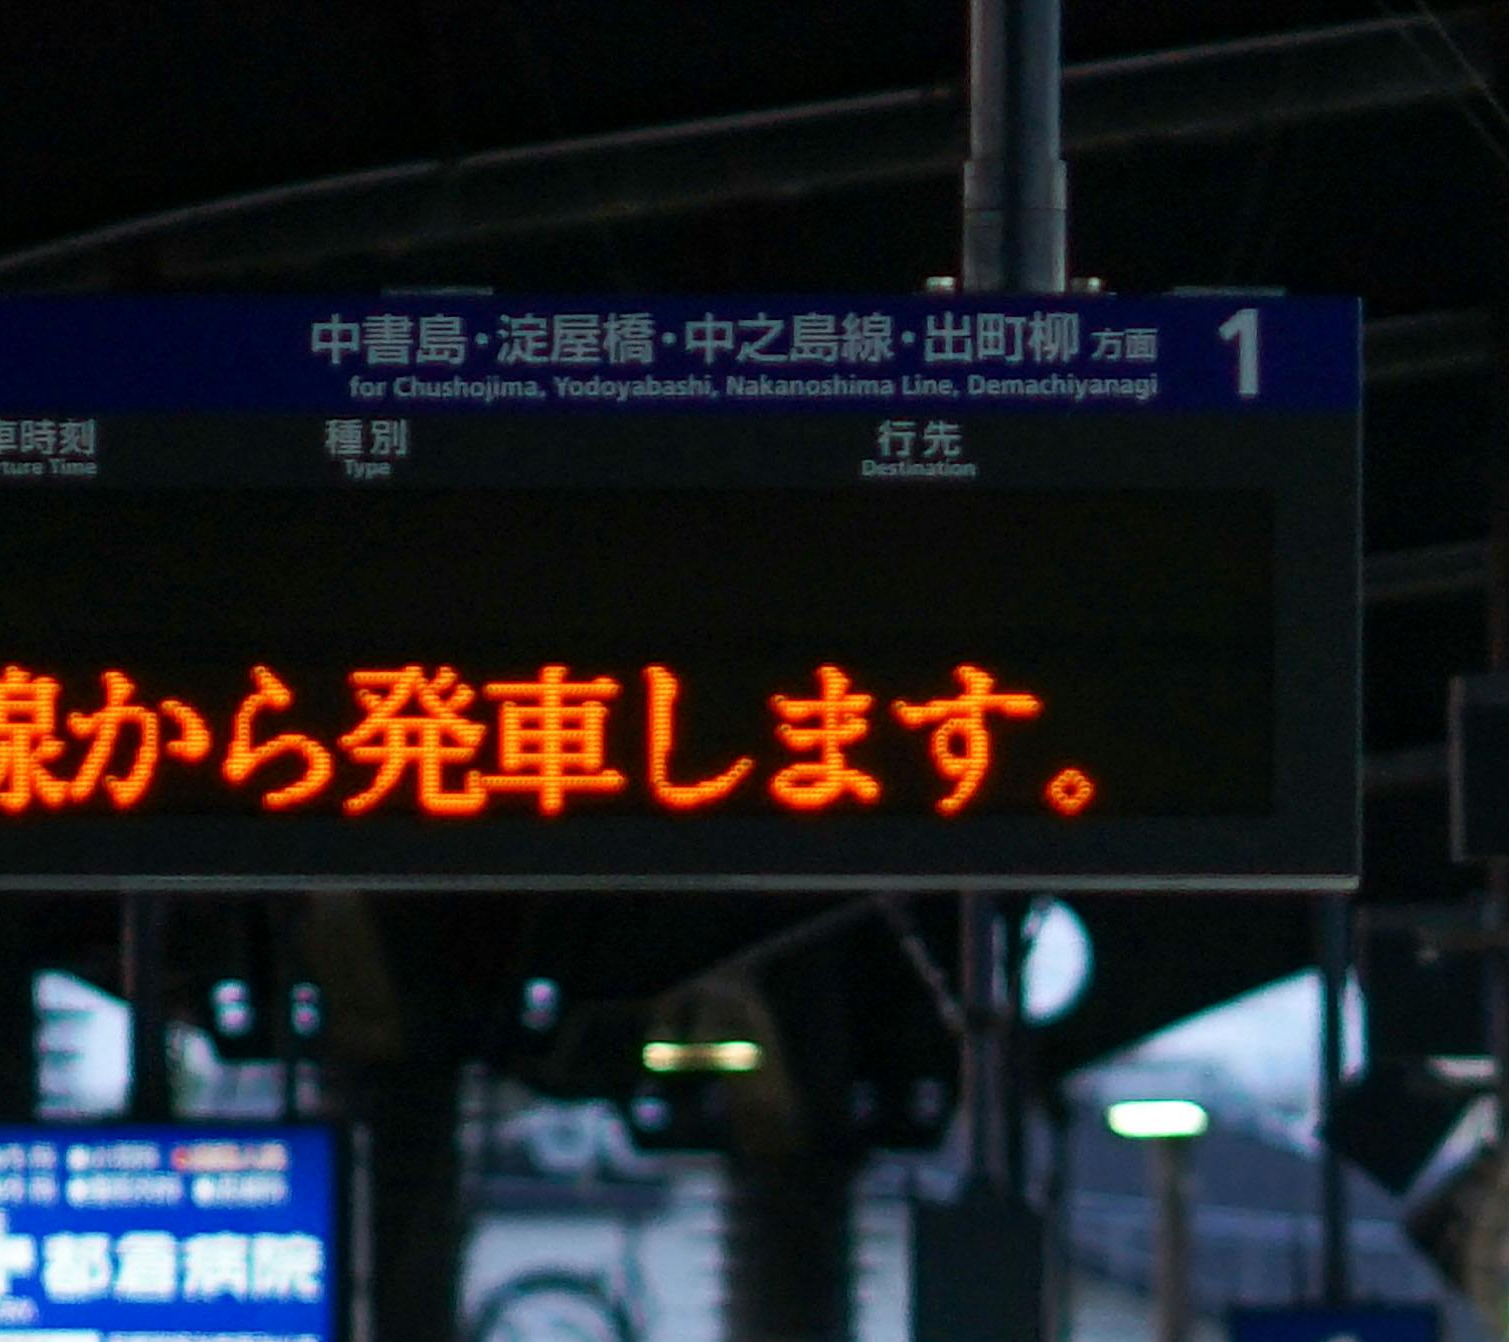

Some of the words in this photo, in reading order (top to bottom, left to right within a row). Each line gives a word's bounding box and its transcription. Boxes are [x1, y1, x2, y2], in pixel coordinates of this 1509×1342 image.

[1092, 327, 1158, 361] 方面
[1218, 308, 1261, 398] 1
[349, 376, 386, 398] for
[393, 375, 546, 403] Chushojima,
[553, 375, 719, 403] Yodoyabashi,
[726, 374, 893, 397] Nakanoshima
[901, 374, 959, 400] Line,
[968, 374, 1158, 401] Demachiyanagi
[324, 418, 409, 456] 種別
[877, 420, 962, 457] 行先
[51, 459, 98, 474] Time
[344, 459, 391, 478] Type
[861, 460, 976, 477] Destination
